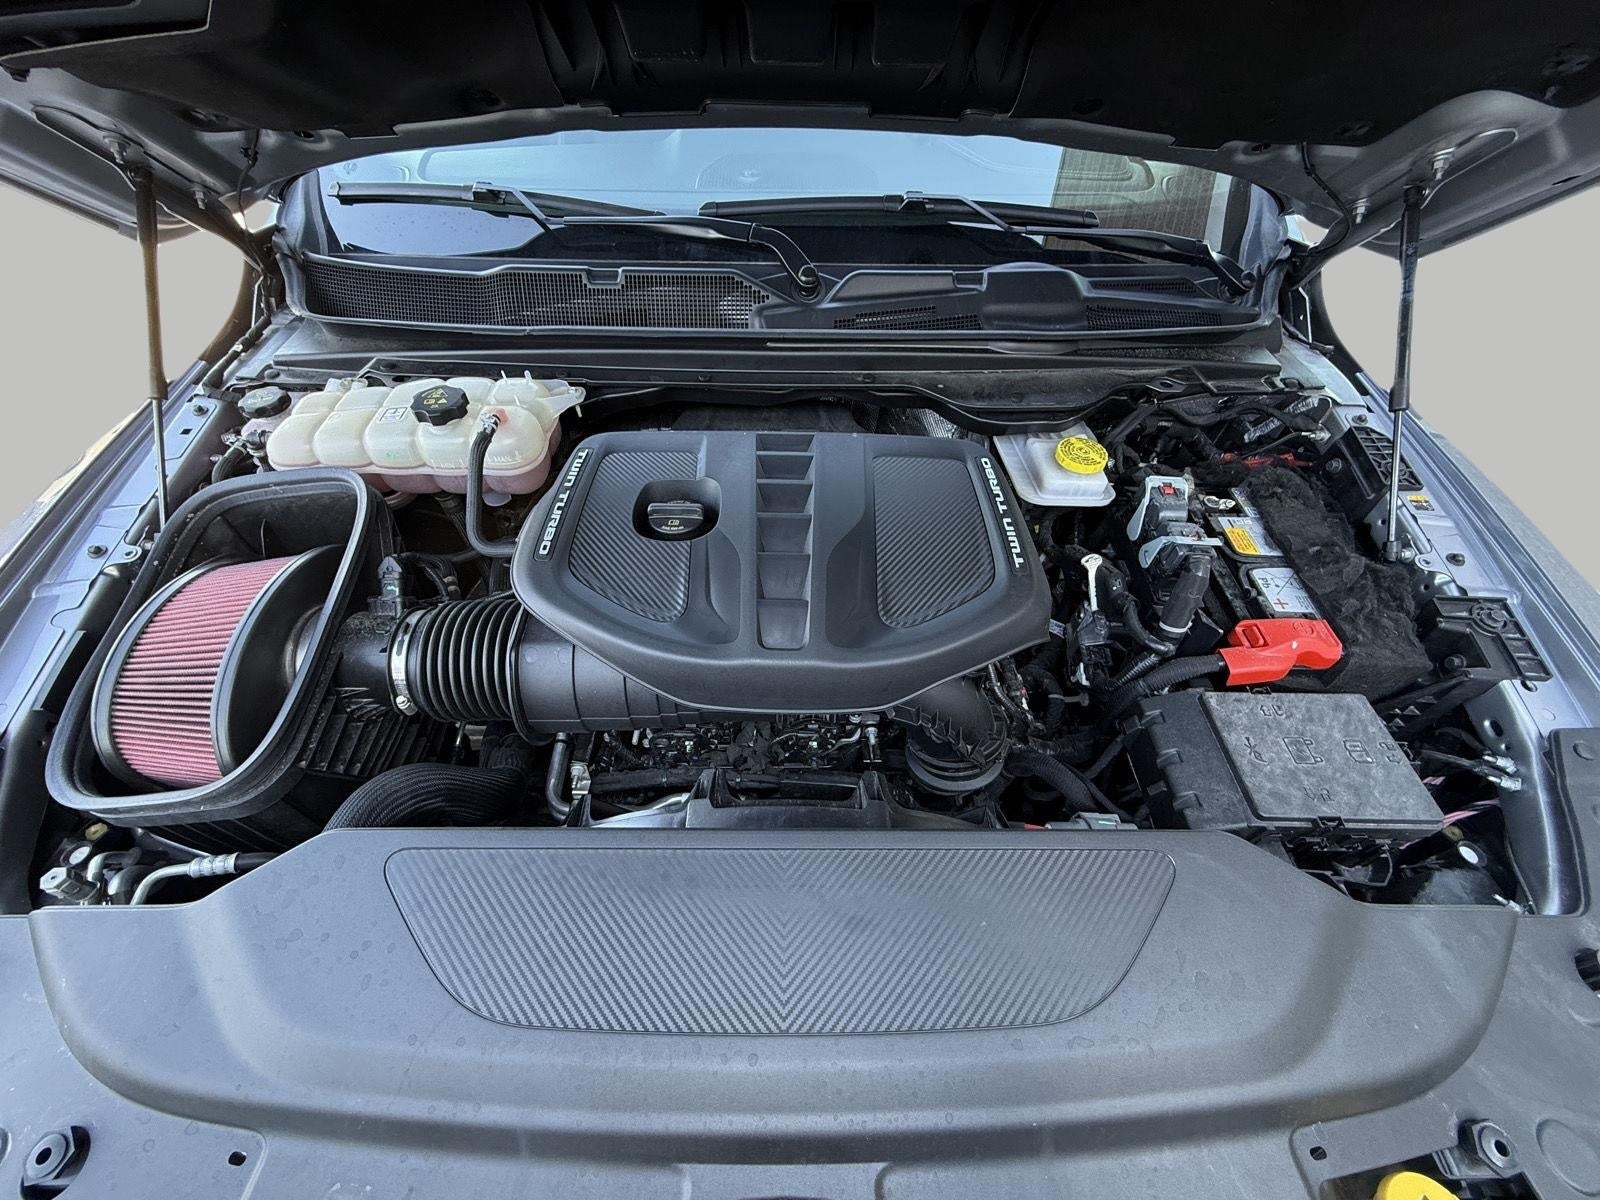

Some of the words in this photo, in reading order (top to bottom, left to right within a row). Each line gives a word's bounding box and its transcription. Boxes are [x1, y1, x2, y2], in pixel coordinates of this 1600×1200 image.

[564, 449, 588, 487] TWIN
[981, 457, 1008, 514] TURBO
[539, 490, 570, 555] TURBO
[1003, 518, 1024, 568] TWIN
